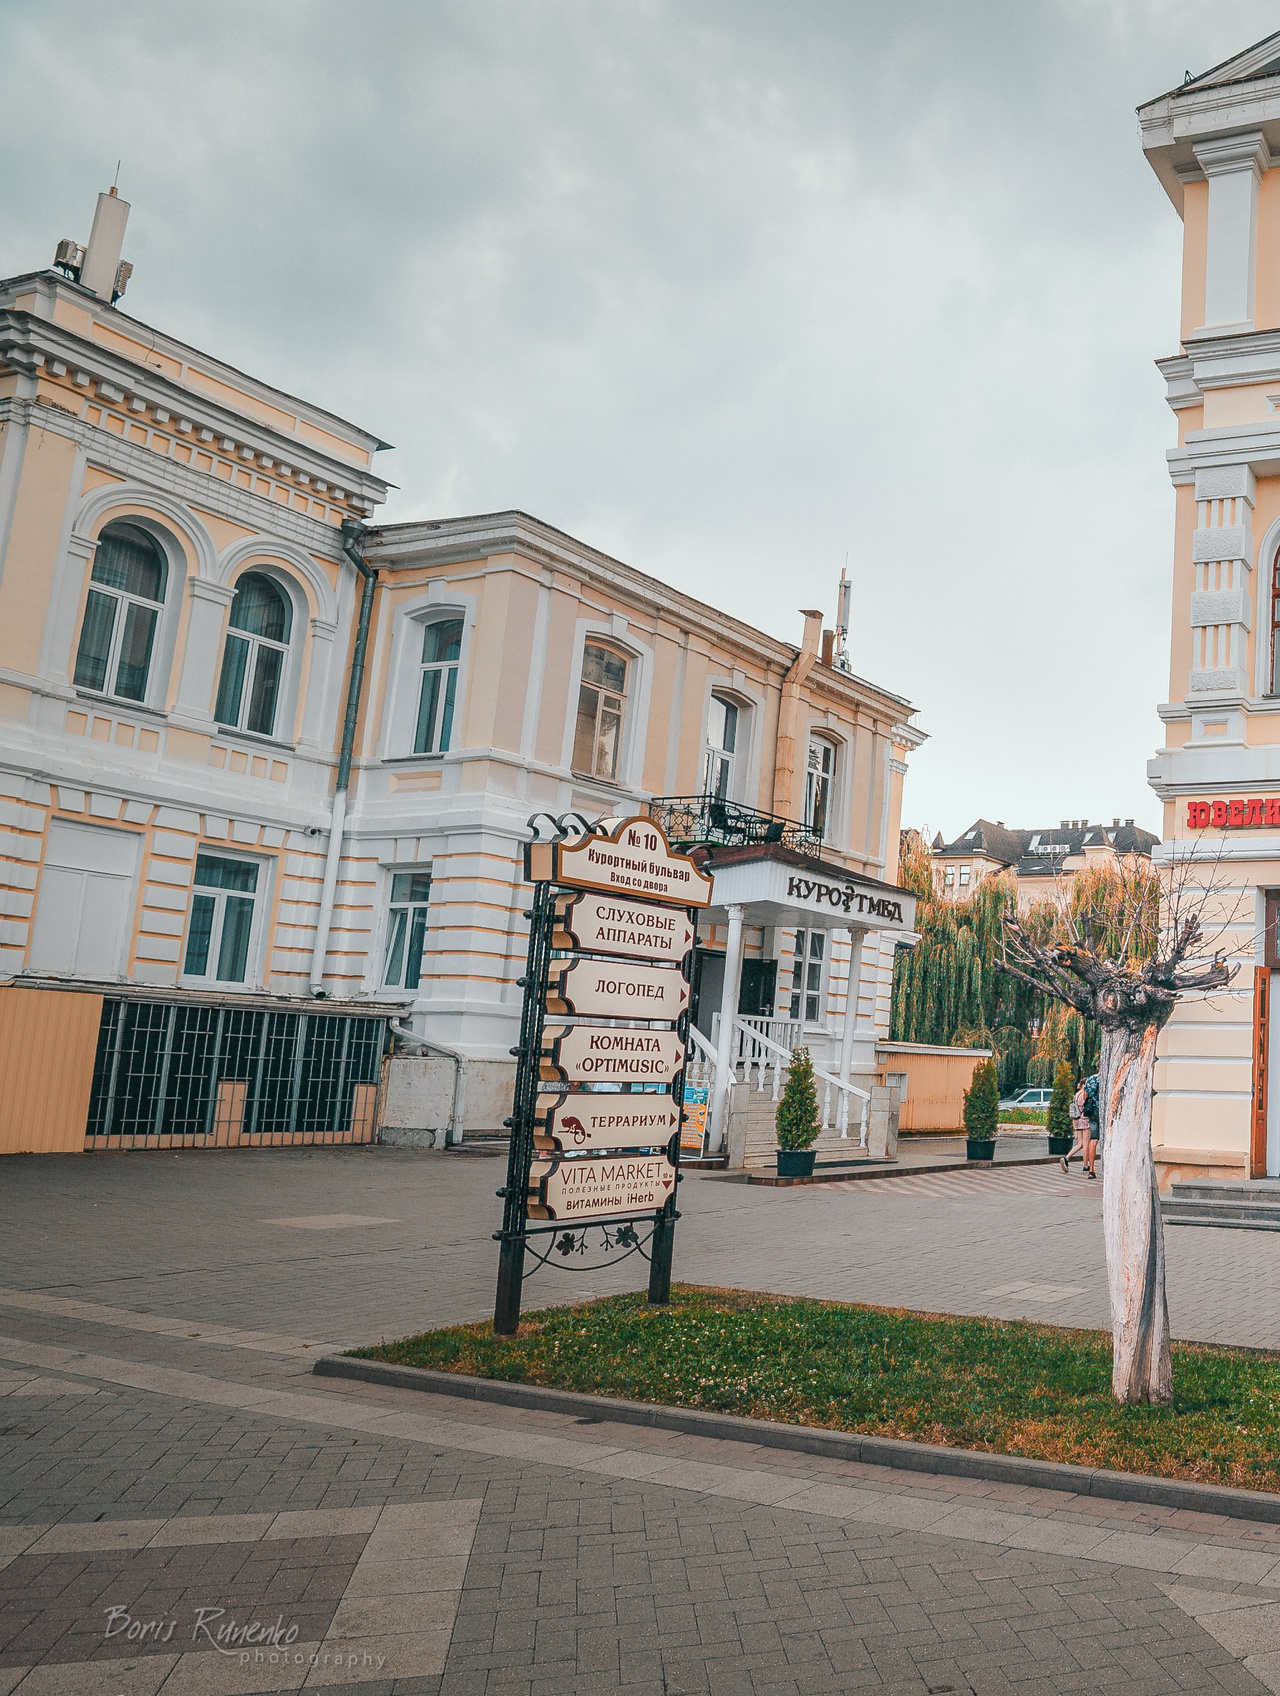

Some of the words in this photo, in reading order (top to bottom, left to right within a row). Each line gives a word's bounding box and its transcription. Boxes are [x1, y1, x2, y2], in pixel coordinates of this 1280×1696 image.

[628, 829, 641, 848] №
[643, 833, 658, 851] 10
[588, 849, 647, 873] Курортный
[649, 862, 690, 882] бульвар
[610, 872, 631, 886] Вход
[632, 877, 642, 887] со
[643, 879, 668, 893] двора
[596, 906, 676, 931] СЛУХОВЫЕ
[595, 927, 672, 950] АППАРАТЫ
[595, 980, 665, 1000] ЛОГОПЕД
[589, 1035, 661, 1052] КОМНАТА
[575, 1058, 670, 1074] «OPTIMUSIC»
[591, 1115, 666, 1128] ТЕРРАРИУМ
[561, 1167, 597, 1185] VITA
[601, 1162, 664, 1182] MARKET
[562, 1184, 611, 1195] ПОЛЕЗНЫЕ
[615, 1180, 660, 1190] ПРОДУКТЫ
[566, 1195, 622, 1210] ВИТАМИНЫ
[626, 1192, 654, 1205] iHerb
